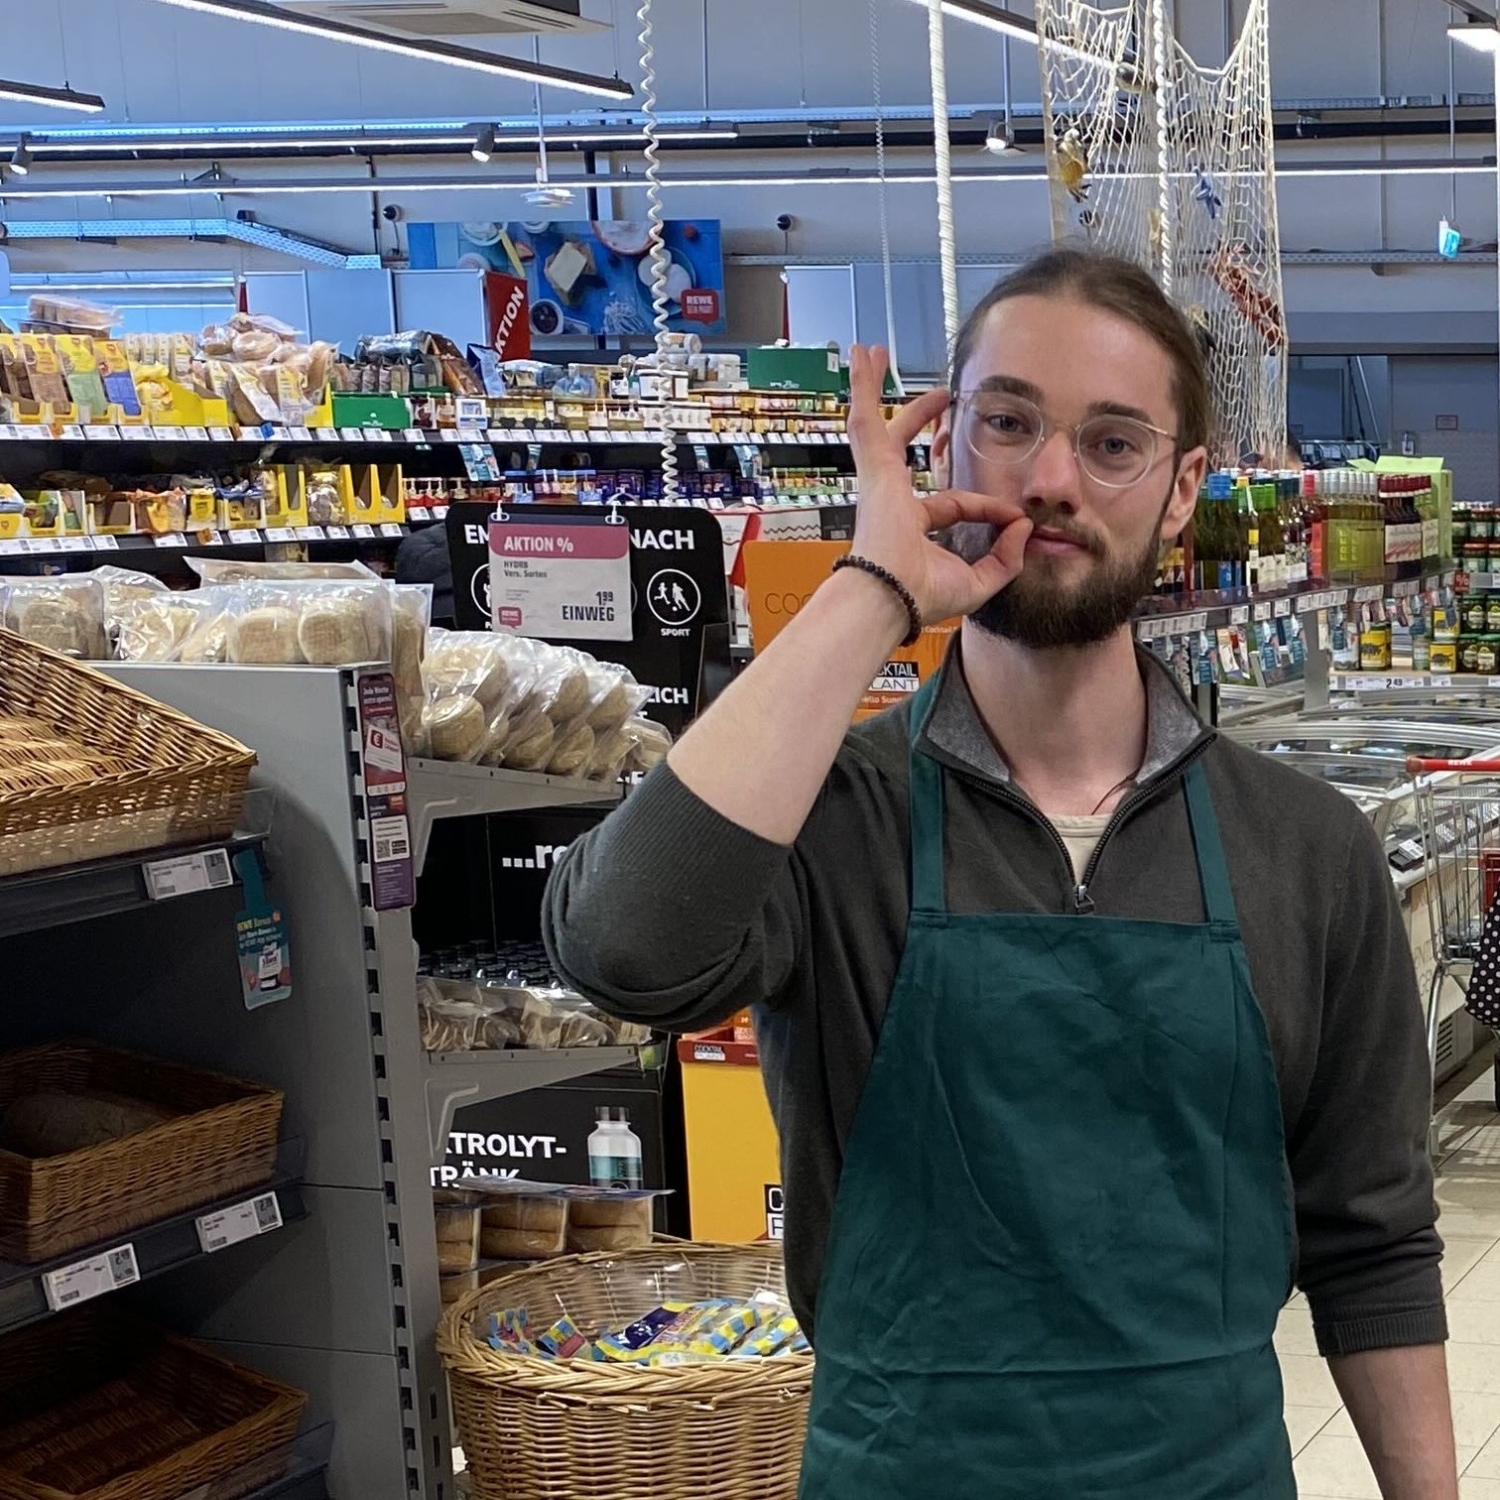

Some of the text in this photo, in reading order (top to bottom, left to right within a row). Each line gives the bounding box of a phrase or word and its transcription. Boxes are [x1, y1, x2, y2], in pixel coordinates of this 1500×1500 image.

[686, 296, 713, 305] REWE
[494, 285, 524, 355] KTION
[503, 536, 574, 553] AKTION %
[562, 605, 615, 622] EINWEG
[660, 628, 691, 637] SPORT
[878, 662, 917, 677] KTAIL
